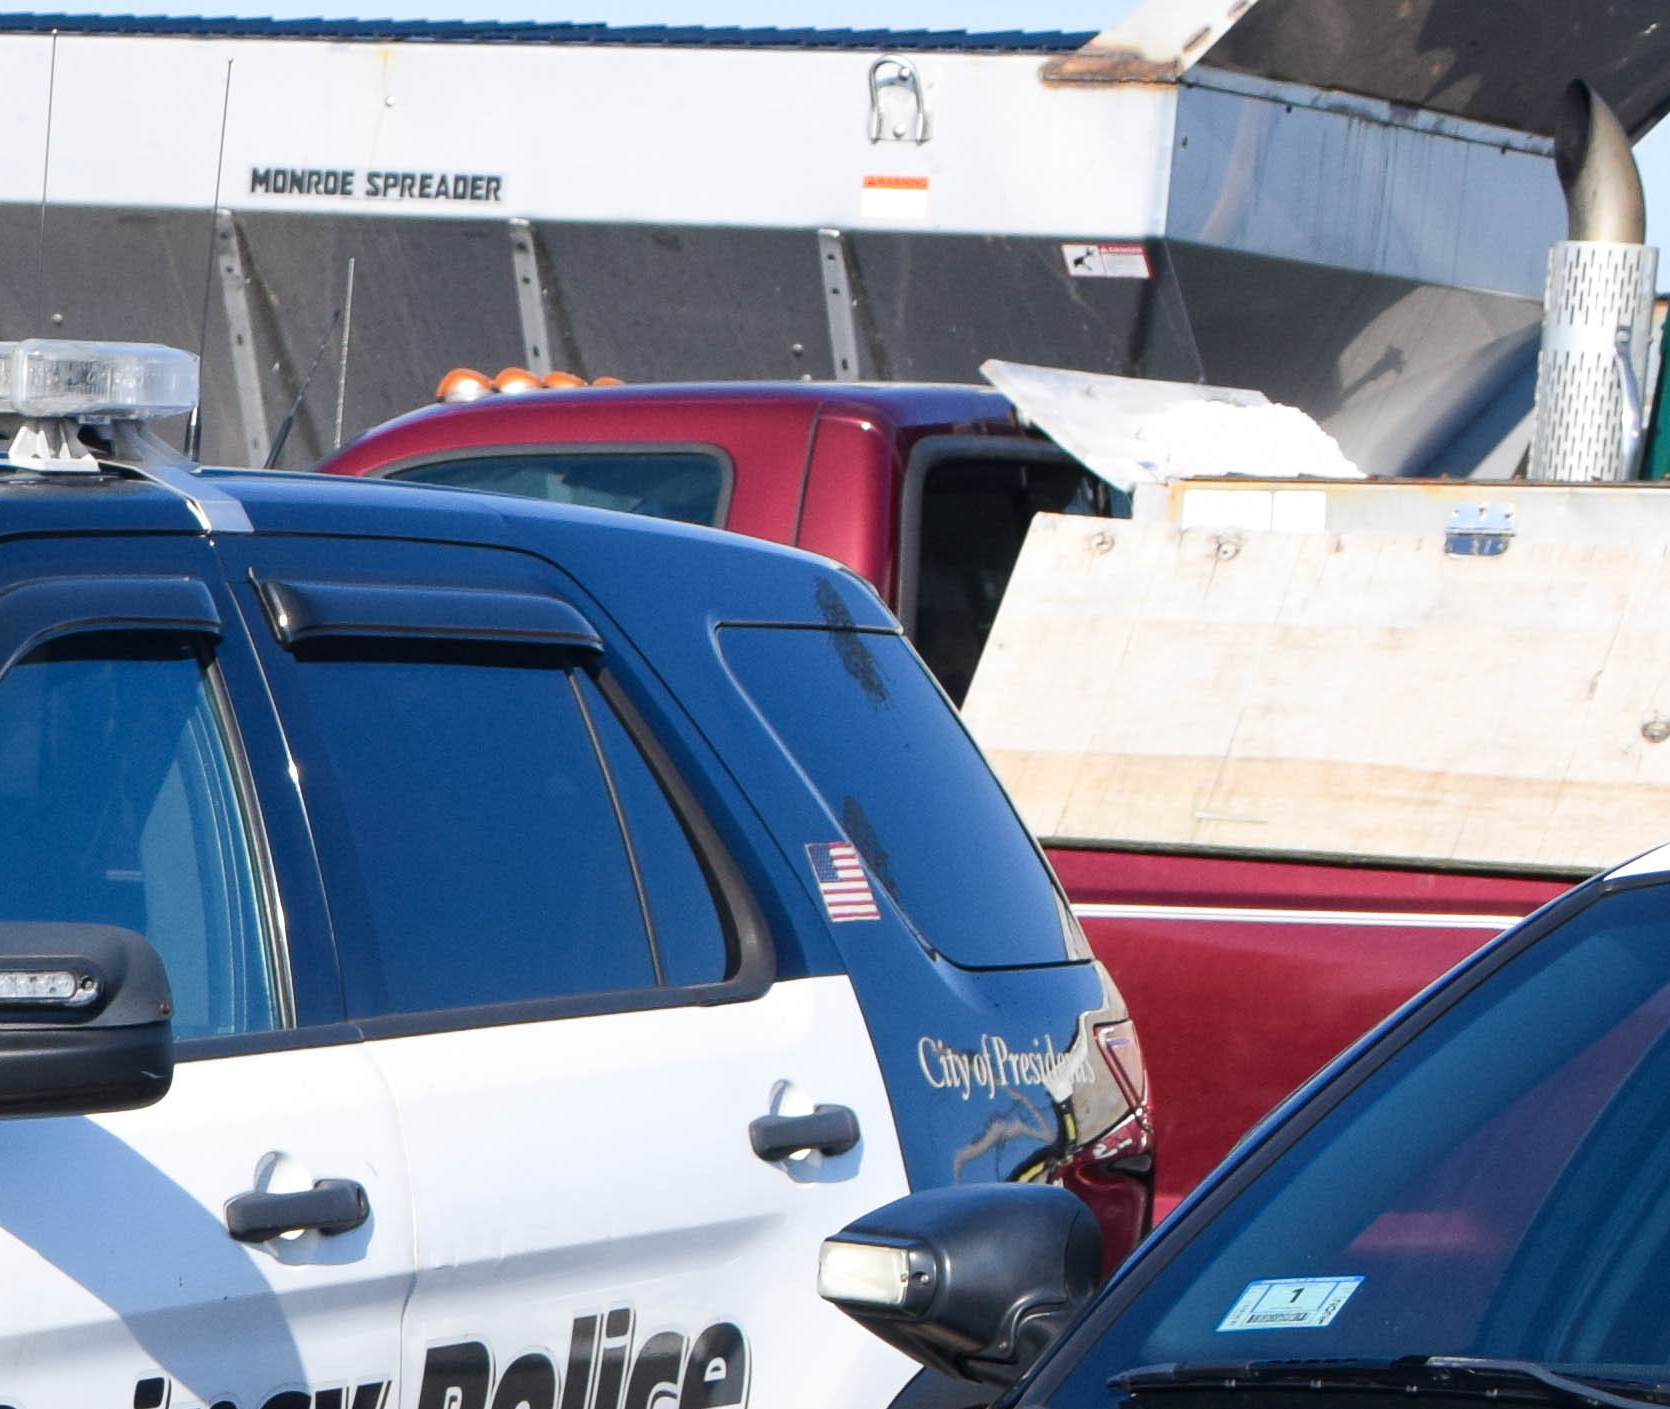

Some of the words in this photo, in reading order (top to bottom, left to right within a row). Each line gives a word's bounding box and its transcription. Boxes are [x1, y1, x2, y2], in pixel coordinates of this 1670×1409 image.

[250, 167, 355, 196] MONROE
[365, 170, 502, 201] SPREADER
[917, 1035, 971, 1101] City
[973, 1033, 996, 1100] of
